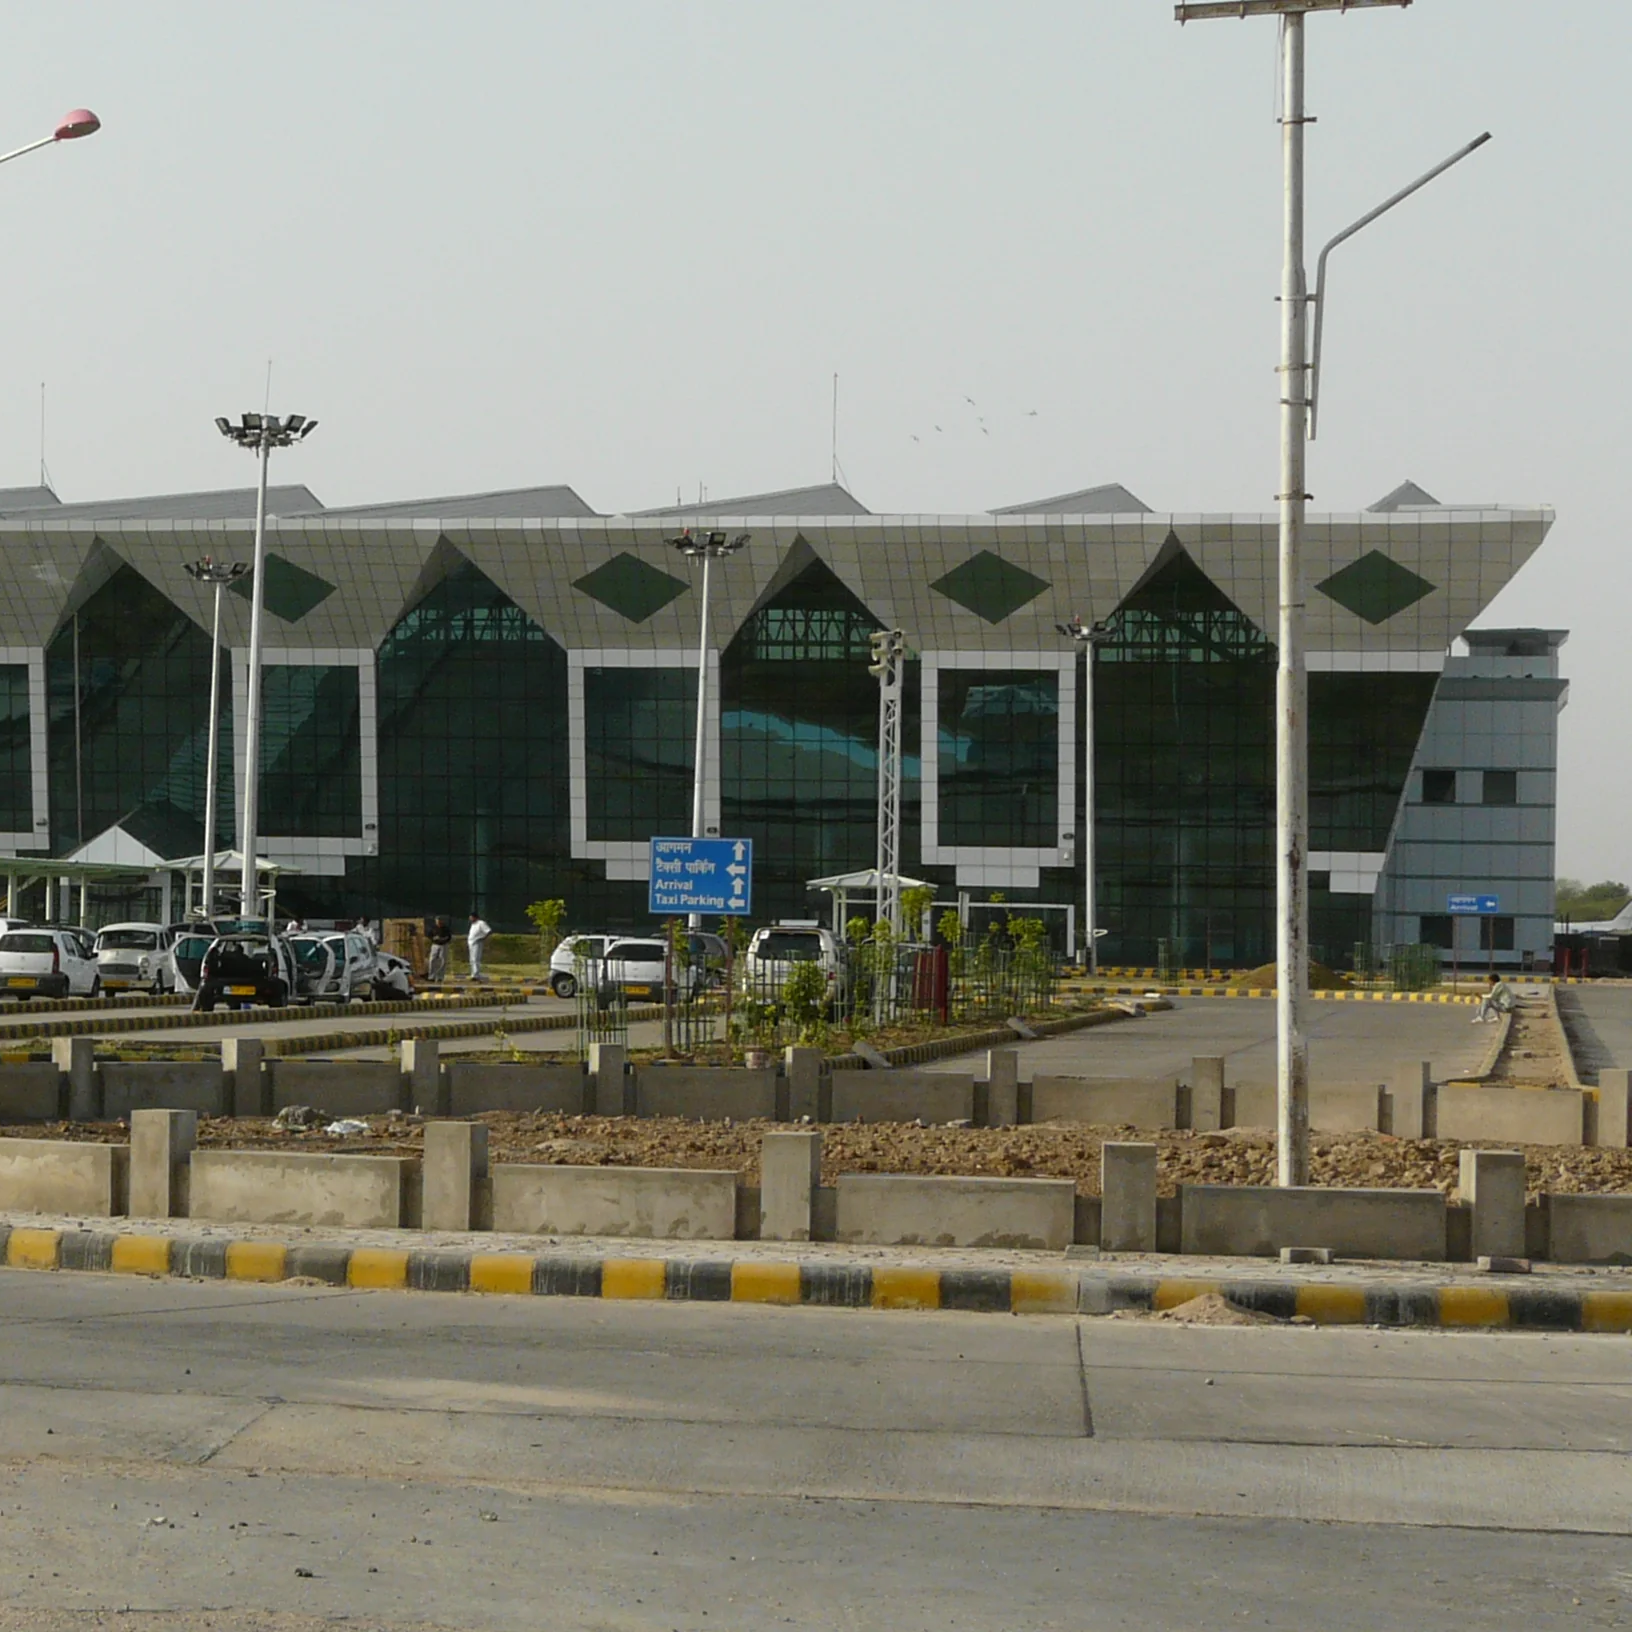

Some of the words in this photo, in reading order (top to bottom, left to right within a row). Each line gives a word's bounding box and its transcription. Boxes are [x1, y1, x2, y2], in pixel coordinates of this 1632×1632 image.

[654, 879, 693, 891] Arrival
[654, 893, 678, 905] Taxi
[679, 894, 725, 909] Parking
